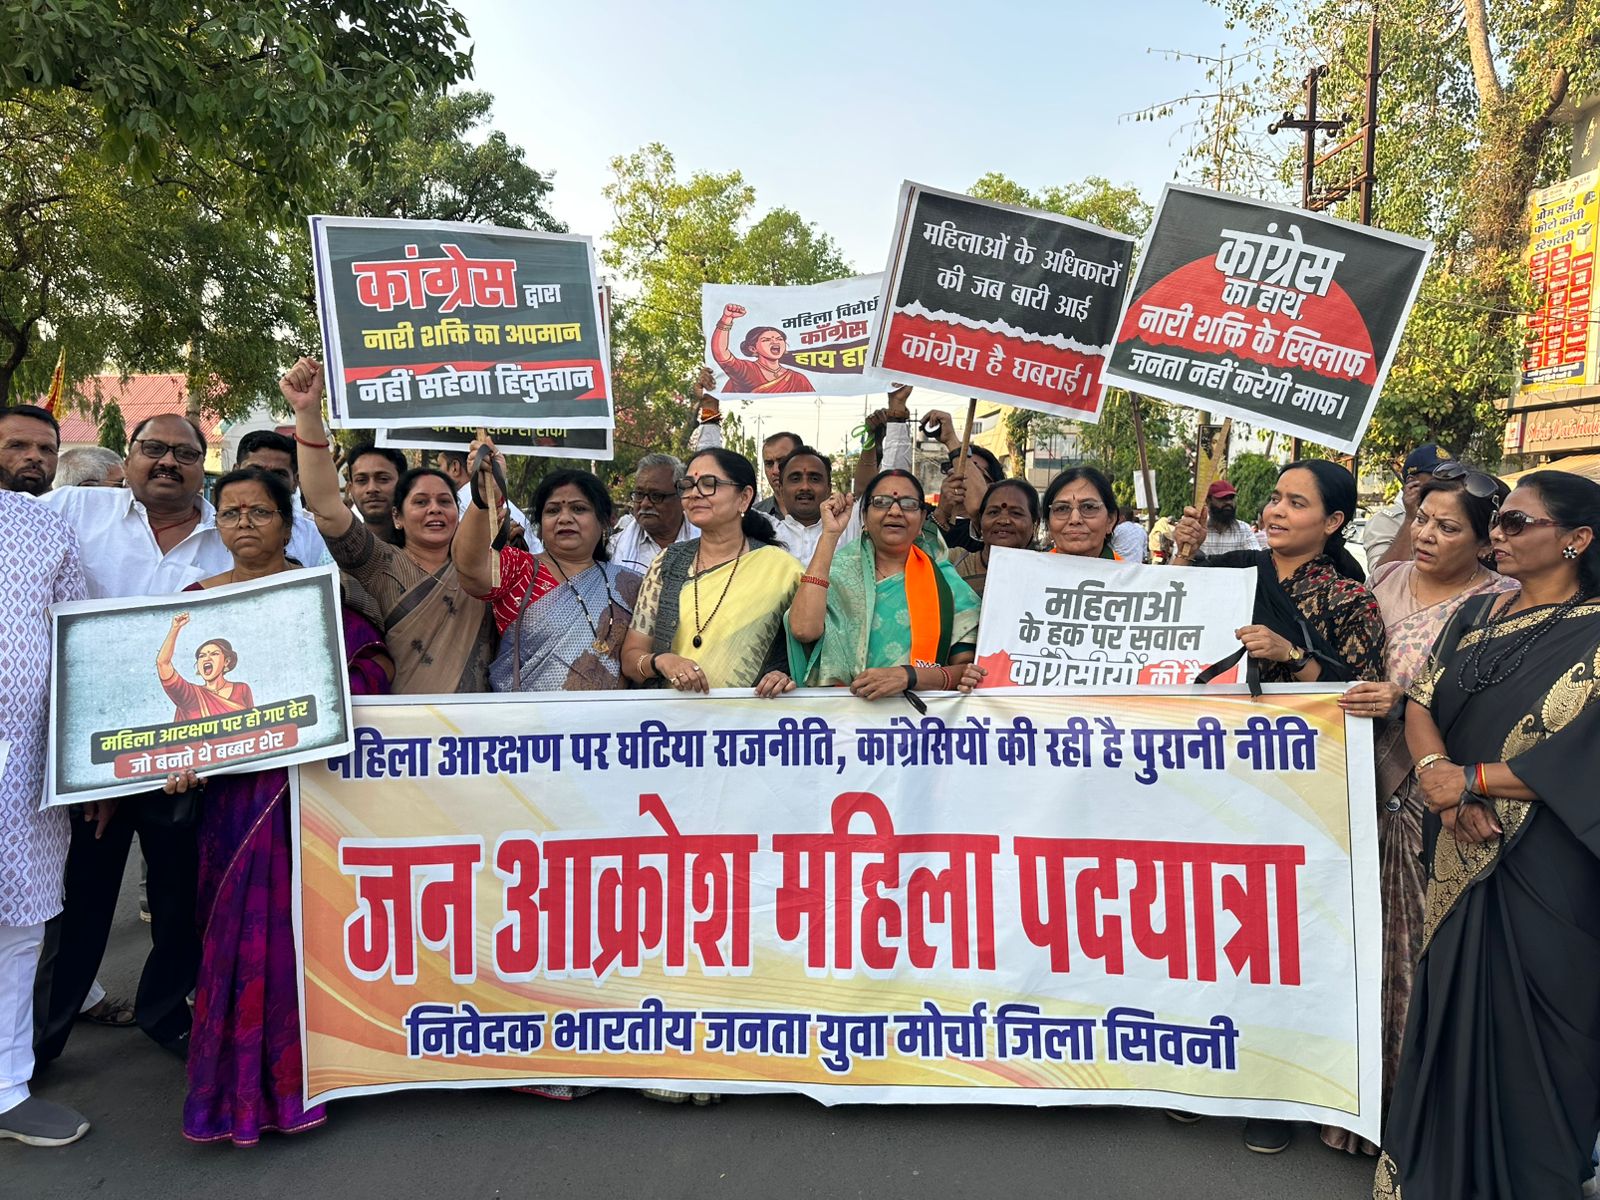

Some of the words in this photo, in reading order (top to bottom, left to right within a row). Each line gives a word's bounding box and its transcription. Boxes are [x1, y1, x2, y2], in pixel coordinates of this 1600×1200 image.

[1535, 218, 1557, 233] फोटो
[1560, 208, 1584, 225] कॉपी
[923, 221, 1011, 260] महिलाओं
[1013, 237, 1036, 265] के
[1041, 249, 1123, 288] अधिकारों
[1214, 222, 1346, 296] कांग्रेस
[352, 244, 517, 313] कांग्रेस
[523, 284, 561, 308] द्वारा
[937, 265, 966, 292] की
[970, 275, 1005, 300] जब
[1010, 284, 1050, 311] बारी
[1054, 296, 1092, 322] आई
[1221, 276, 1257, 308] का
[362, 321, 414, 350] नारी
[420, 318, 470, 347] शक्ति
[473, 324, 500, 345] का
[505, 323, 581, 345] अपमान
[782, 311, 832, 329] महिला
[836, 296, 879, 319] विरोध
[792, 350, 837, 368] हाय
[840, 345, 868, 368] हा
[901, 333, 980, 371] कांग्रेस
[986, 344, 1006, 376] है
[1138, 303, 1194, 338] नारी
[1192, 311, 1252, 348] शक्ति
[1251, 321, 1282, 355] के
[1278, 325, 1372, 378] खिलाफ
[356, 368, 413, 403] नहीं
[415, 365, 491, 399] सहेगा
[495, 364, 594, 402] हिंदुस्तान
[1128, 349, 1189, 382] जनता
[1188, 358, 1239, 390] नहीं
[1233, 367, 1293, 405] करेगी
[1045, 580, 1187, 622] महिलाओं
[1019, 612, 1044, 643] के
[1047, 622, 1087, 646] हक
[1091, 625, 1126, 649] पर
[1129, 625, 1204, 650] सवाल
[1150, 660, 1182, 684] की
[101, 729, 154, 752] महिला
[160, 720, 218, 744] आरक्षण
[221, 716, 243, 732] पर
[244, 709, 260, 727] हो
[263, 707, 286, 723] गए
[288, 700, 308, 719] ढेर
[129, 754, 151, 774] जो
[155, 749, 194, 770] बनते
[197, 745, 212, 763] थे
[215, 737, 254, 759] बब्बर
[258, 731, 284, 749] शेर
[439, 733, 564, 776] आरक्षण
[571, 731, 609, 771] पर
[617, 721, 707, 768] घटिया
[713, 717, 847, 774] राजनीति,
[856, 716, 991, 766] कांग्रेसियों
[996, 717, 1037, 767] की
[1045, 717, 1093, 768] रही
[1095, 717, 1125, 769] है
[1132, 717, 1227, 786] पुरानी
[1235, 717, 1317, 771] नीति
[340, 840, 483, 980] जन
[495, 793, 759, 980] आक्रोश
[772, 792, 999, 971] महिला
[1013, 836, 1305, 987] पदयात्रा
[406, 1003, 545, 1056] निवेदक
[555, 998, 696, 1053] भारतीय
[702, 1011, 811, 1053] जनता
[817, 1013, 886, 1072] युवा
[895, 1001, 988, 1060] मोर्चा
[995, 1003, 1097, 1062] जिला
[1102, 1006, 1240, 1071] सिवनी
